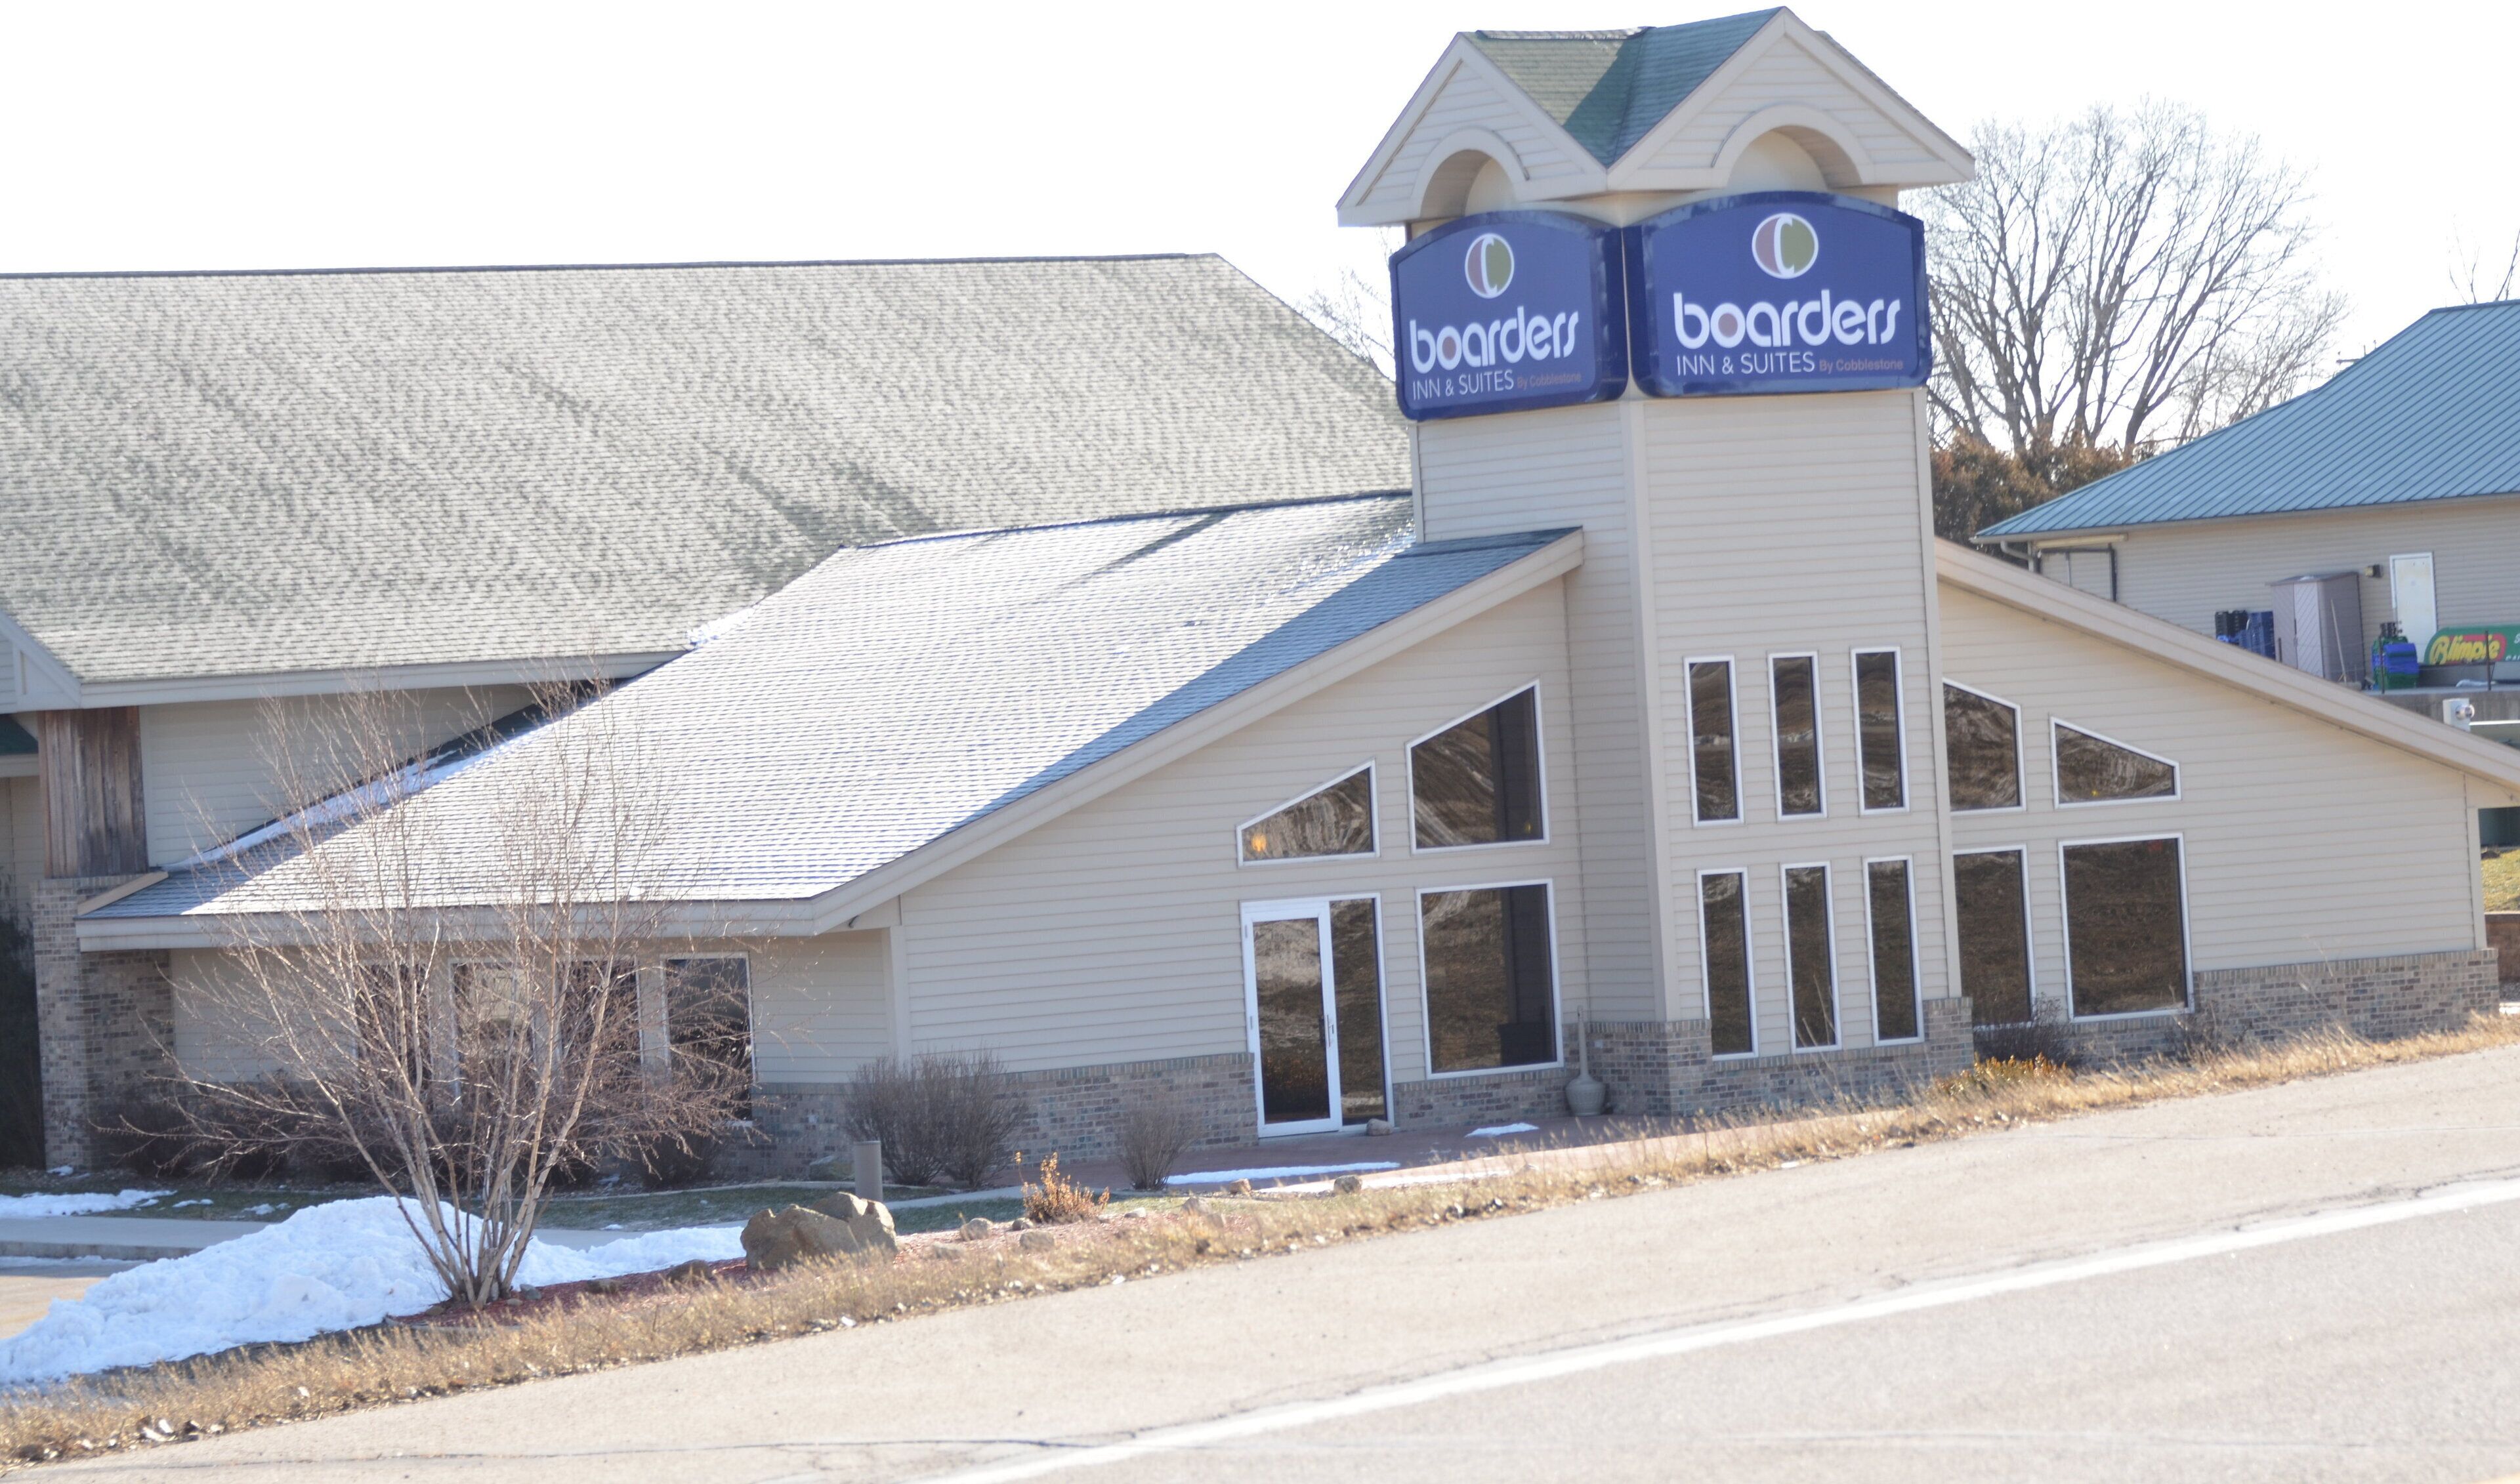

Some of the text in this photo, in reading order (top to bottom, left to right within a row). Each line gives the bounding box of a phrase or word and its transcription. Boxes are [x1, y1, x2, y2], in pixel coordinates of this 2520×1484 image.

[1410, 306, 1578, 374] boarders
[1673, 289, 1900, 349] boarders
[1413, 369, 1582, 400] INN & SUITES By Cobblestone
[1677, 352, 1903, 376] INN & SUITES By Cobblestone
